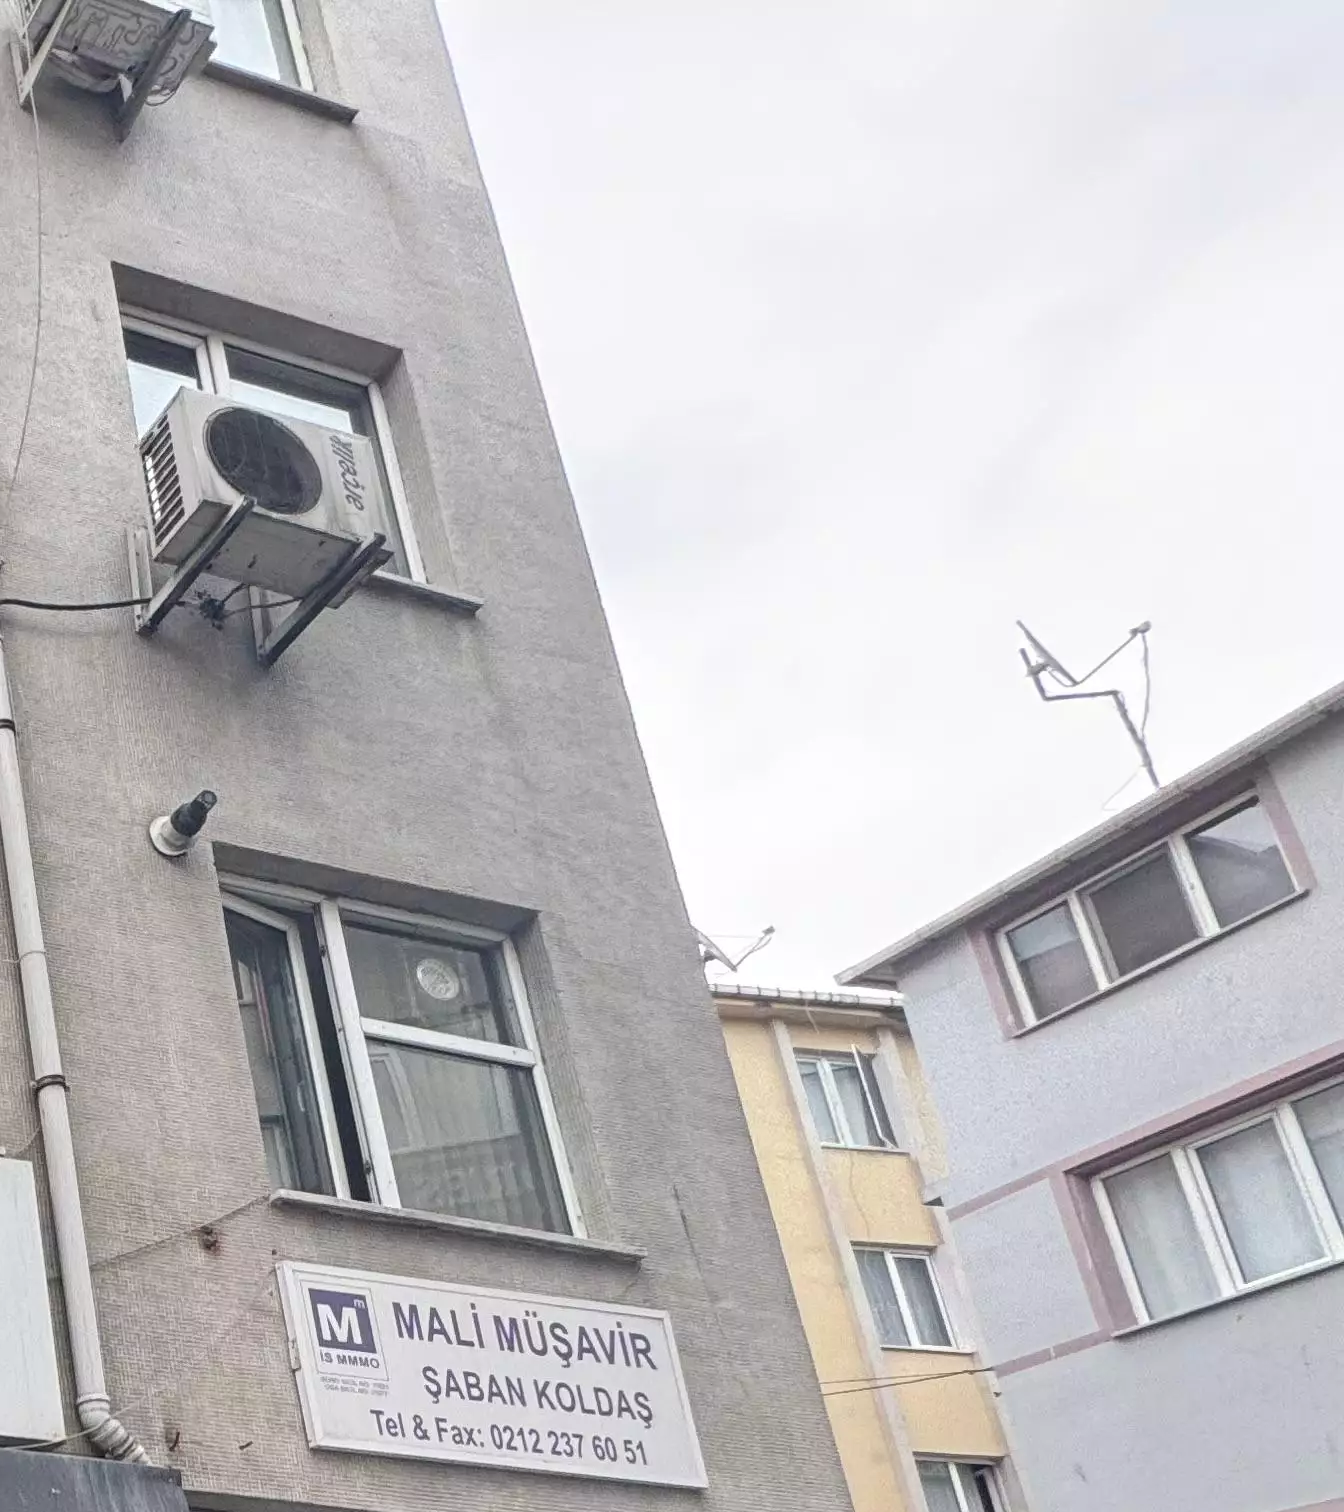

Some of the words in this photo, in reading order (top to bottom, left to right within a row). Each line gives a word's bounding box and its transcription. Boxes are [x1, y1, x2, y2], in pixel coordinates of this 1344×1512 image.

[329, 435, 366, 512] arçelik
[392, 1302, 486, 1350] MALİ
[493, 1310, 659, 1371] MÜŞAVİR
[422, 1365, 528, 1405] ŞABAN
[533, 1378, 654, 1430] KOLDAŞ
[369, 1408, 406, 1439] Tel
[412, 1413, 430, 1442] &
[434, 1416, 485, 1449] Fax:
[489, 1423, 545, 1455] 0212
[546, 1429, 584, 1459] 237
[591, 1435, 618, 1464] 60
[623, 1438, 649, 1467] 51
